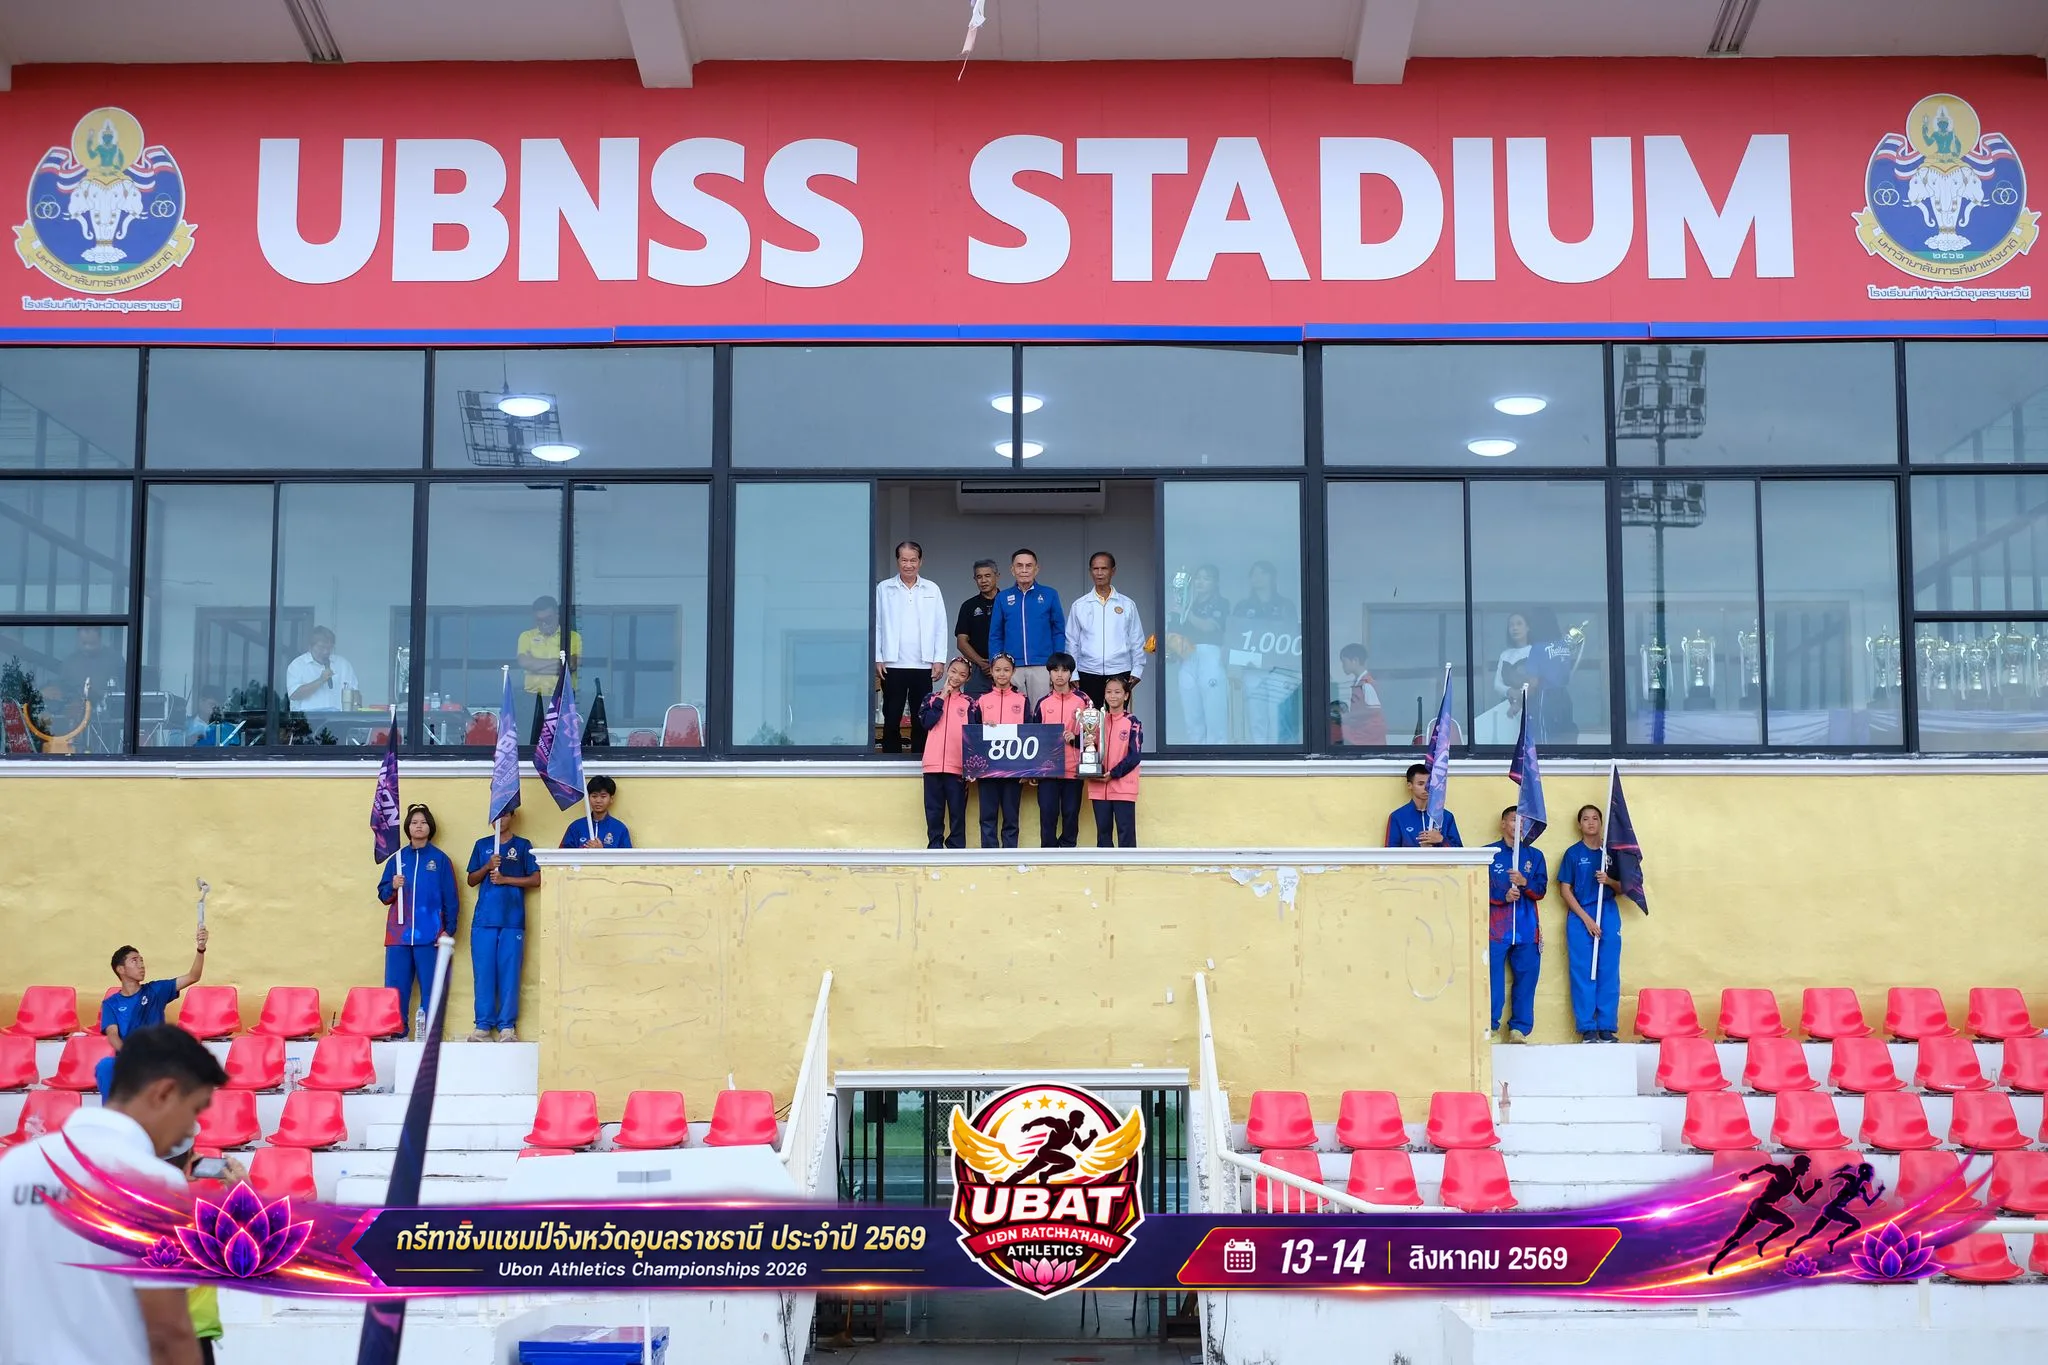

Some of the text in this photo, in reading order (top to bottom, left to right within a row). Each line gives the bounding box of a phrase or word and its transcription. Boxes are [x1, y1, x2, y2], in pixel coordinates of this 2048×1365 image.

[256, 134, 1795, 288] UBNSS STADIUM
[1877, 238, 2019, 276] มหาวิทยาลัยการกีฬาแห่งชาติ
[1932, 252, 1965, 260] ๒๕๖๒
[88, 264, 119, 272] ๒๕๖๒
[1869, 286, 2030, 301] โรงเรียนกีฬาจังหวัดอุบลราชธานี
[24, 298, 180, 312] โรงเรียนกีฬาจังหวัดอุบลราชธานี
[988, 736, 1039, 761] 800
